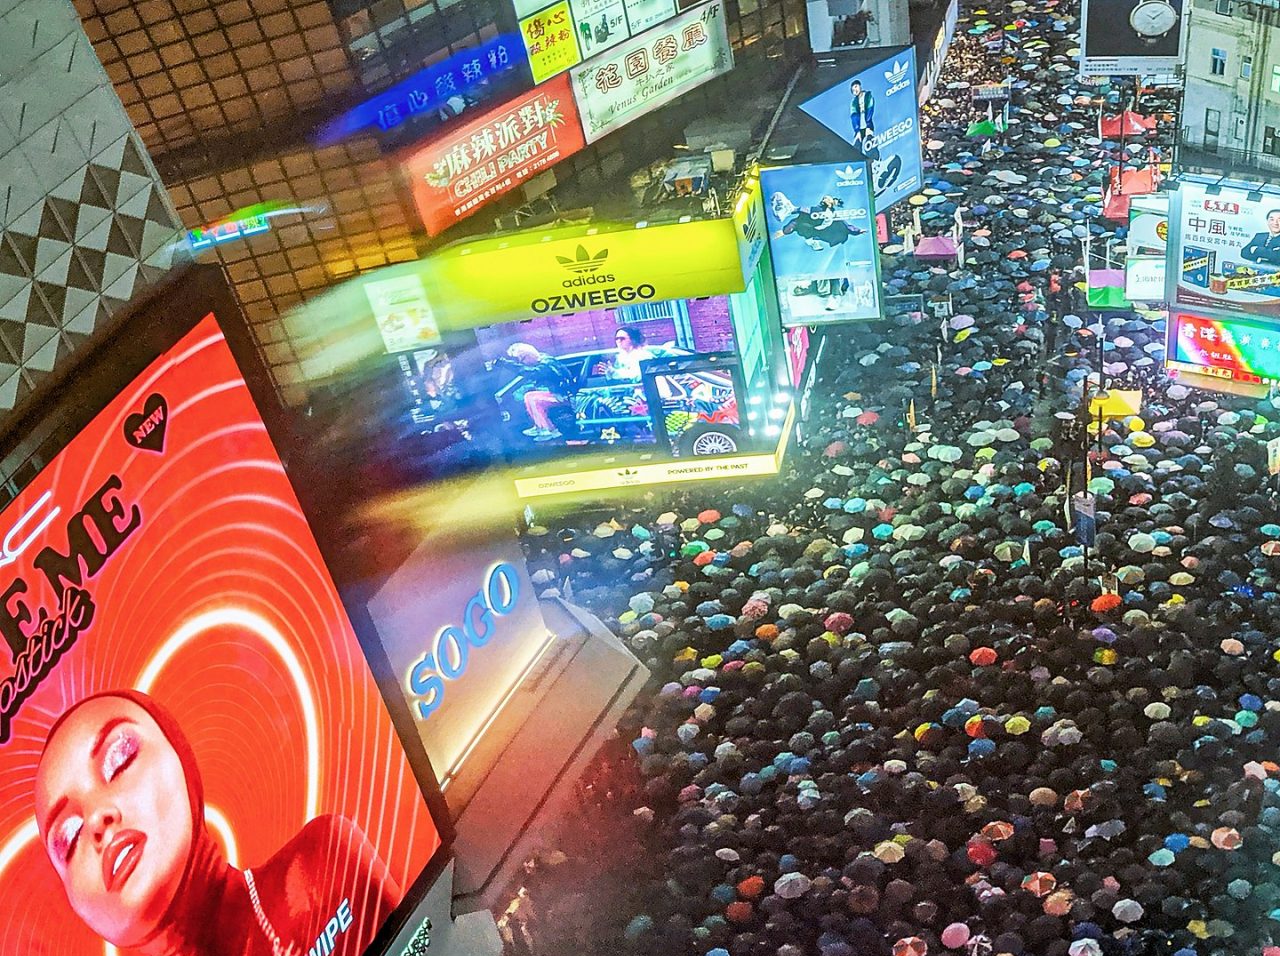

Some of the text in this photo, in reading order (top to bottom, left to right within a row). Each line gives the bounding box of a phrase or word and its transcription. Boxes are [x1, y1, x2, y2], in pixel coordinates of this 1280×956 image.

[526, 10, 565, 39] 傷心
[610, 15, 623, 29] 5/F
[699, 4, 720, 25] 4/F
[529, 27, 571, 56] 酸辣粉
[595, 22, 708, 94] 花園餐廳
[641, 75, 674, 100] Garden
[885, 80, 911, 97] adidas
[446, 99, 547, 178] 麻辣派對
[863, 117, 913, 152] OZWEEGO
[497, 131, 548, 173] PARTY
[1188, 216, 1227, 236] 中風
[562, 272, 616, 288] adidas
[531, 283, 656, 314] OZWEEGO
[133, 405, 166, 445] NEW
[667, 466, 703, 475] POWERED
[715, 464, 730, 472] THE
[730, 463, 748, 471] PAST
[33, 474, 142, 612] ME
[405, 559, 521, 721] SOGO
